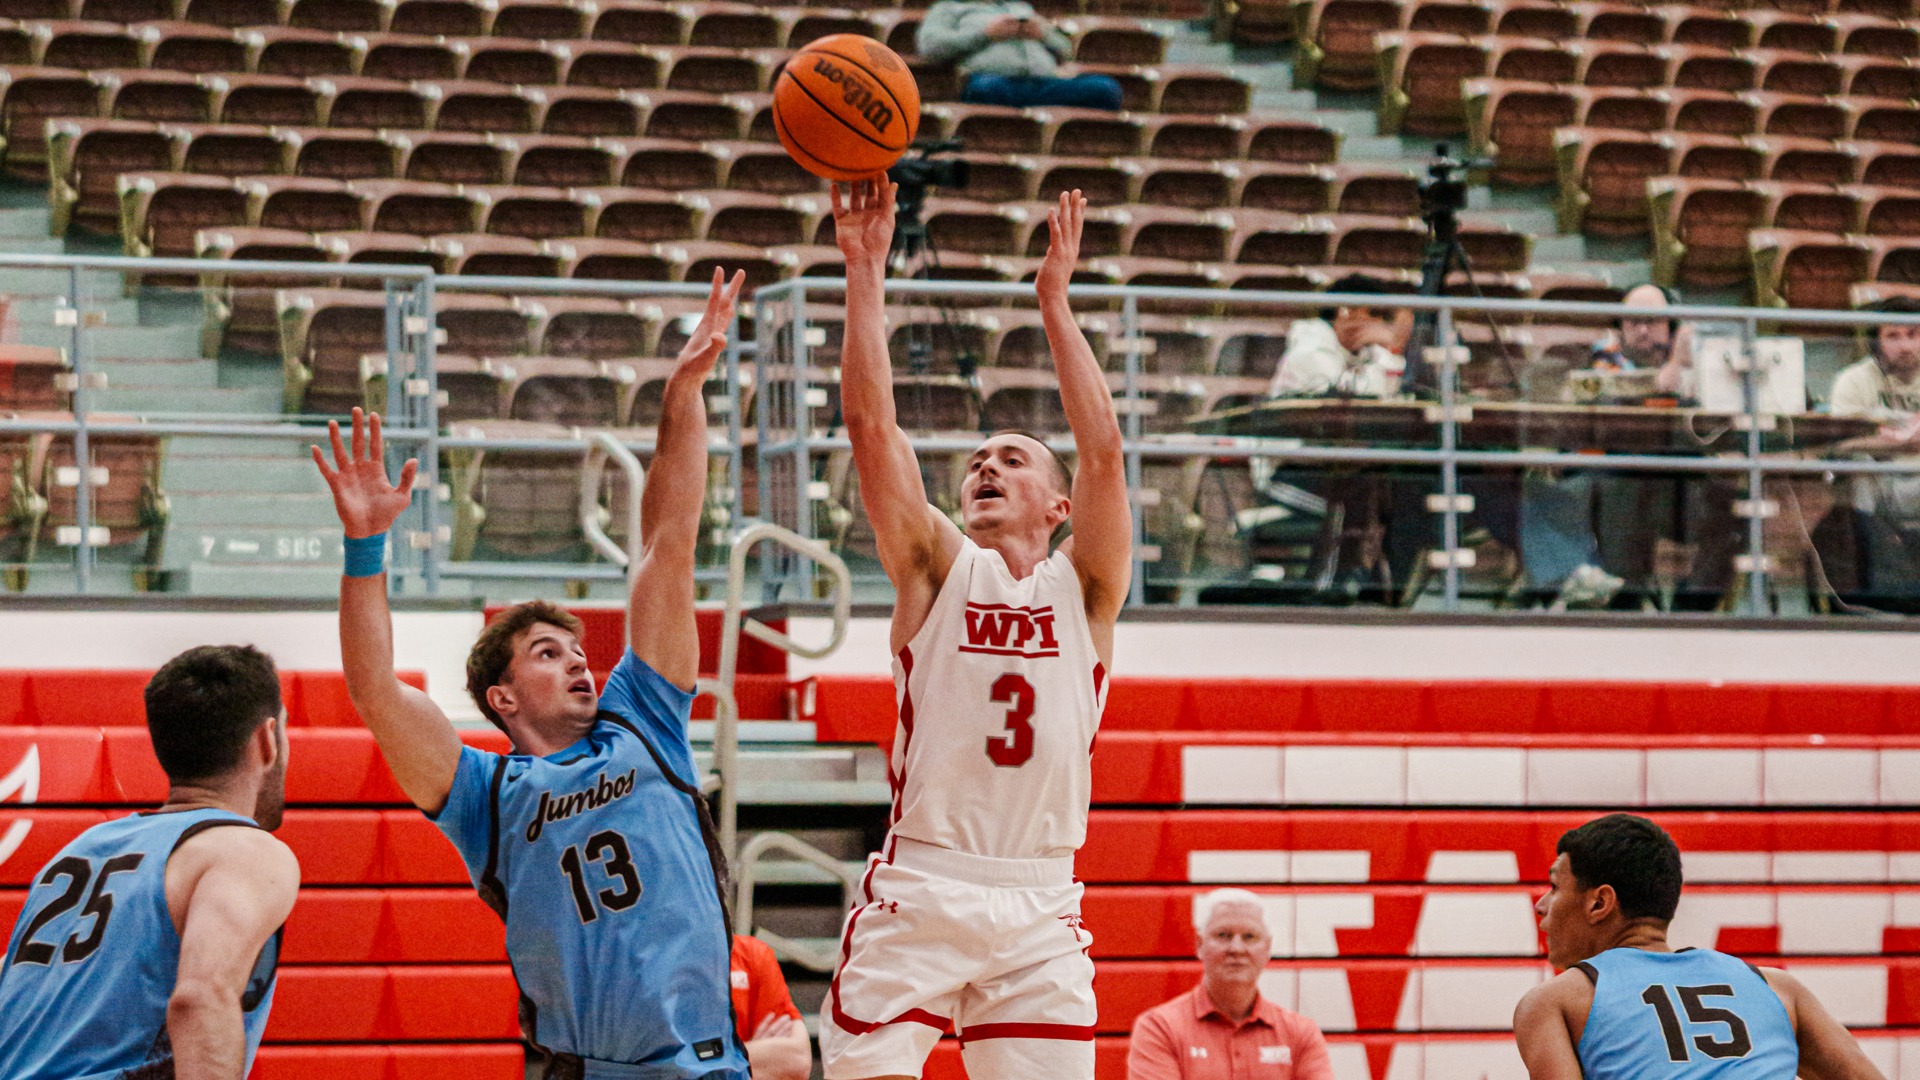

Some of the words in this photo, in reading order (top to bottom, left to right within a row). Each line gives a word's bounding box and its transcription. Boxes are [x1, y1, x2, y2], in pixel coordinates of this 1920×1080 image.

[814, 58, 894, 134] Wilson
[276, 537, 322, 559] SEC
[964, 609, 1060, 650] WPI
[985, 671, 1036, 768] 3
[526, 768, 636, 844] Jumbos
[12, 853, 146, 967] 25
[559, 829, 643, 925] 13
[1640, 983, 1754, 1063] 15
